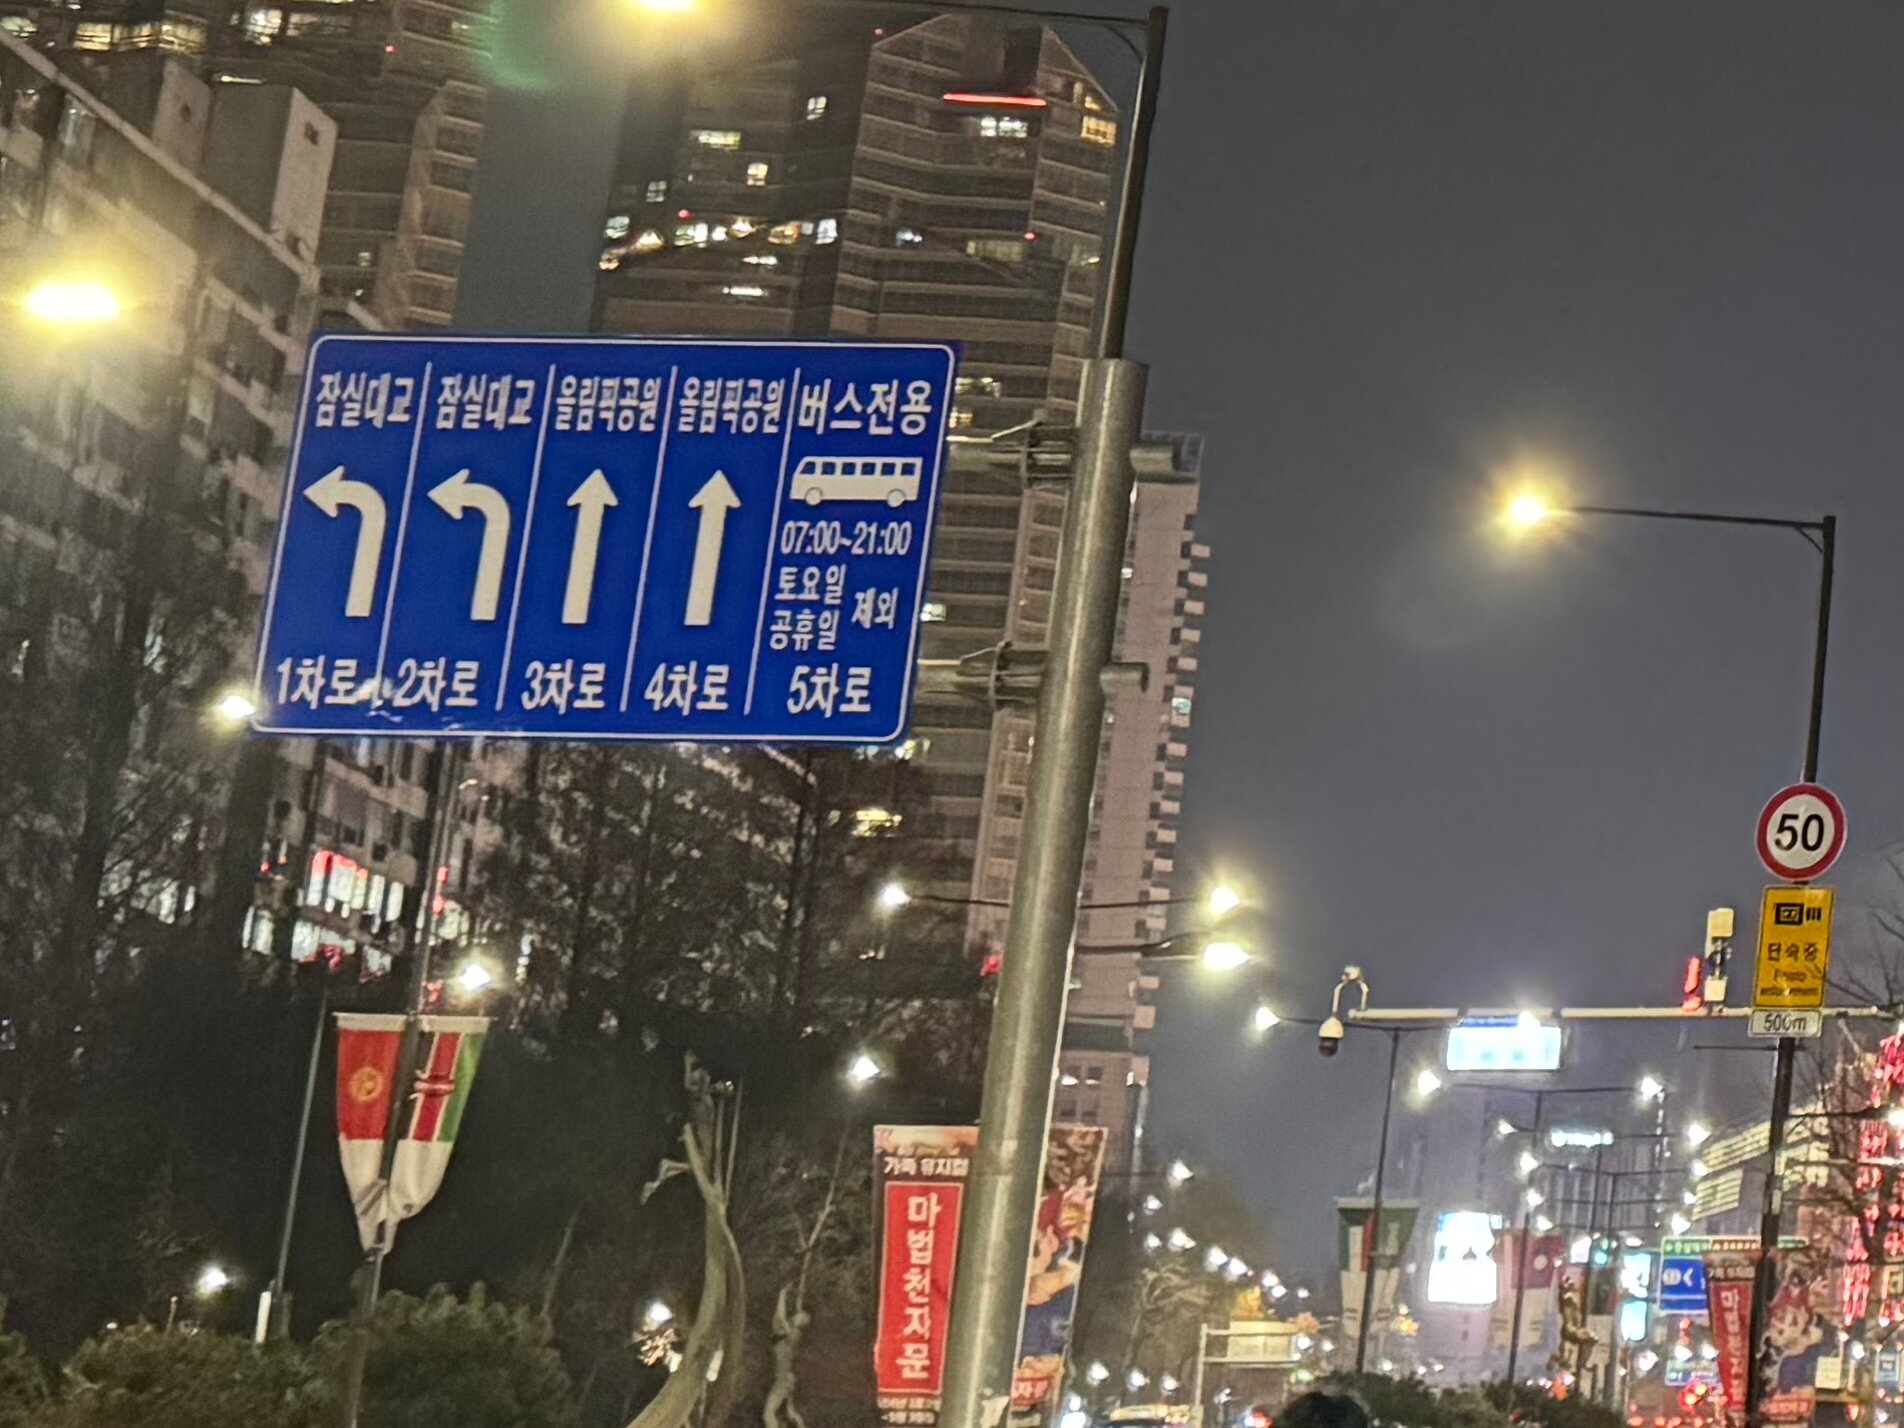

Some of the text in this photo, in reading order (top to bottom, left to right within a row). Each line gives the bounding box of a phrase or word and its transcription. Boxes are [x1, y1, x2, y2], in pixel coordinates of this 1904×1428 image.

[314, 371, 415, 429] 잠실대교
[435, 373, 536, 431] 잠실대교
[555, 375, 662, 432] 올림픽공원
[678, 376, 785, 434] 올림픽공원
[797, 378, 932, 436] 버스전용
[781, 520, 912, 555] 07:00~21:00
[774, 564, 846, 604] 토요일
[851, 587, 899, 629] 제외
[769, 609, 840, 651] 공휴일
[277, 654, 358, 709] 1차로
[393, 656, 479, 712] 2차로
[521, 659, 607, 715] 3차로
[644, 660, 729, 717] 4차로
[786, 662, 873, 718] 5차로
[1775, 813, 1825, 852] 50
[1767, 942, 1818, 962] 단속중
